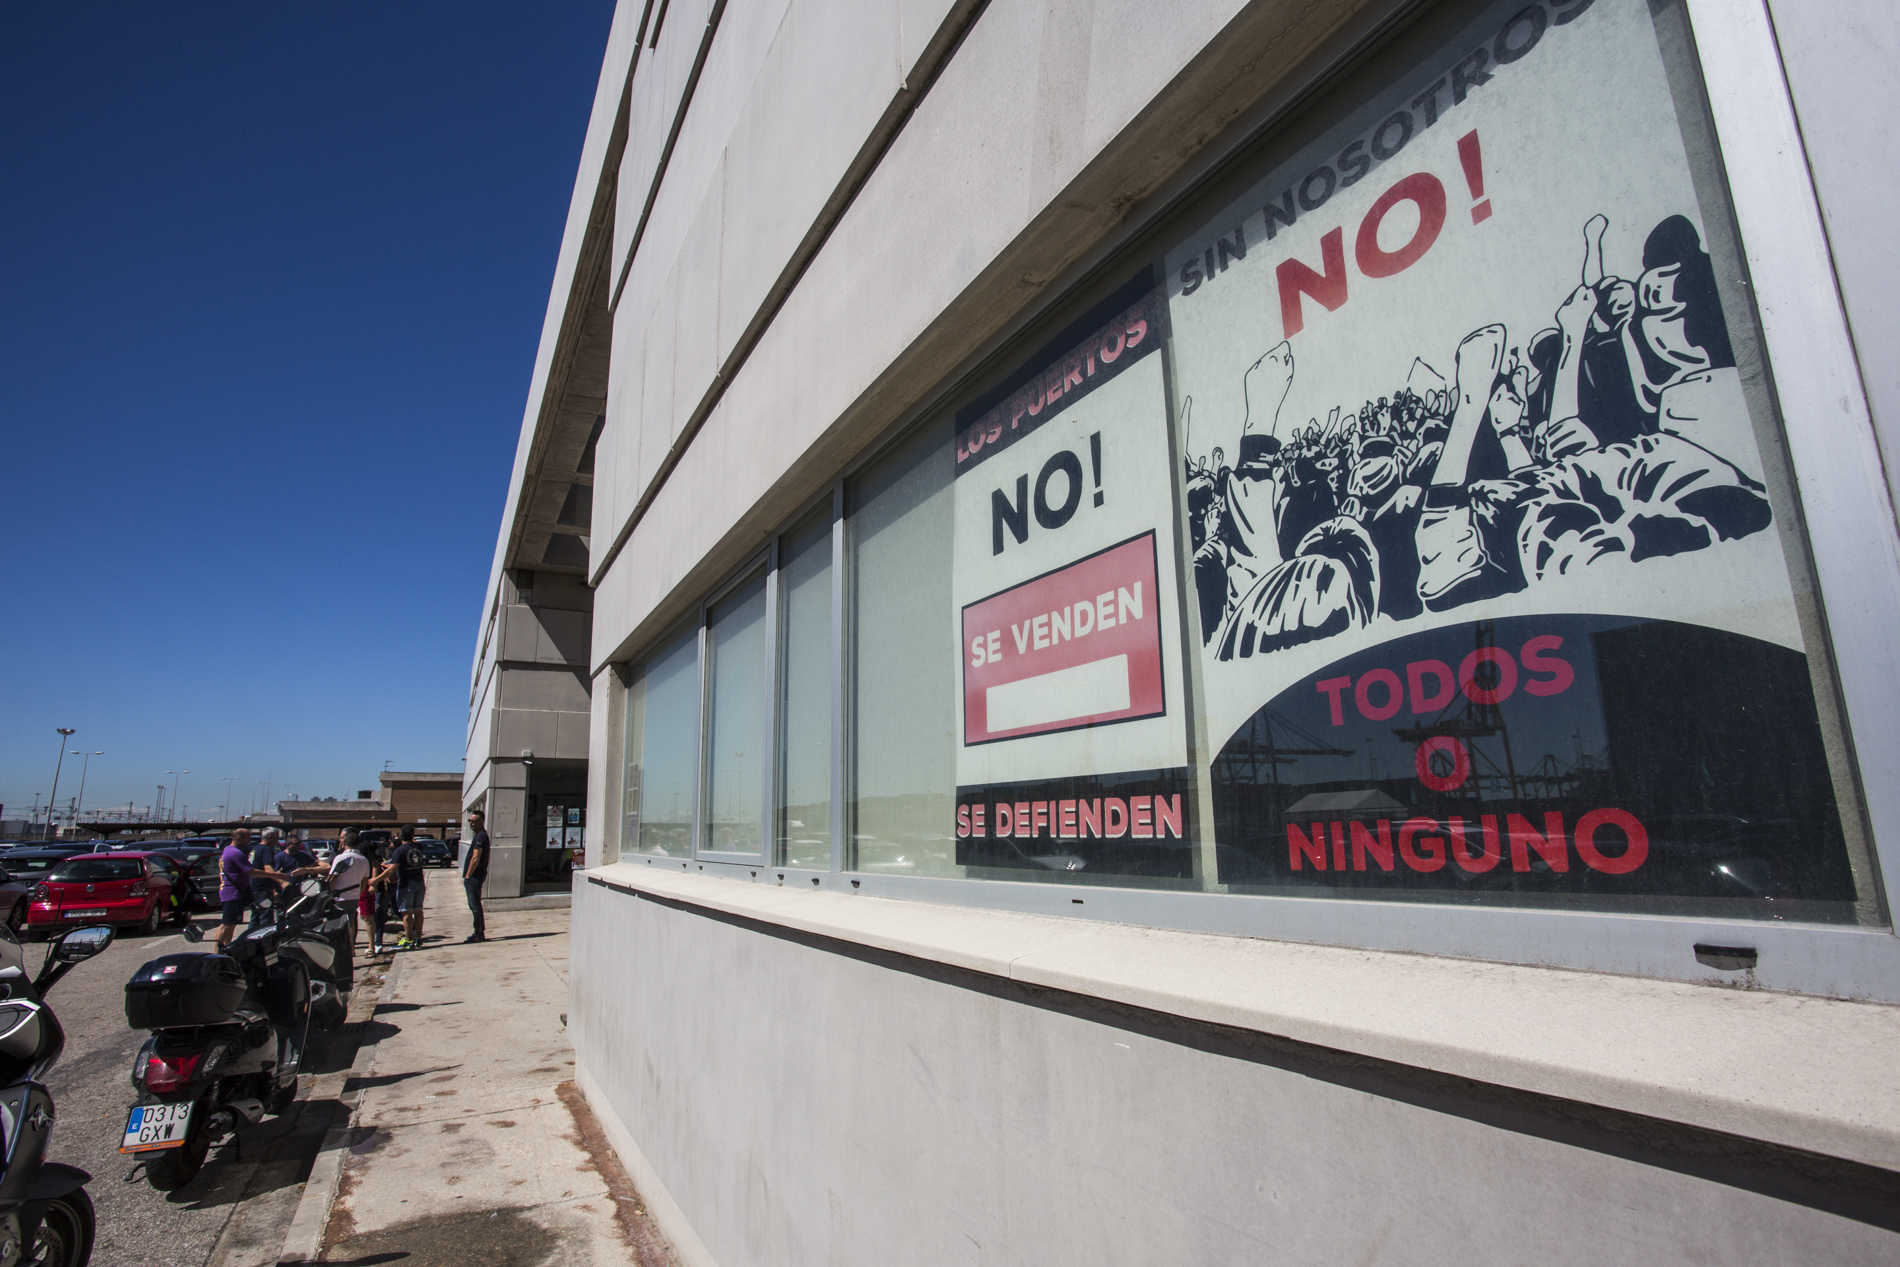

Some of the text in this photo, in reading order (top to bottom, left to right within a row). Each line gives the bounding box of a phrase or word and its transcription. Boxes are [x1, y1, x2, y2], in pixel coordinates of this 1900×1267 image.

[1180, 223, 1247, 297] SIN
[1275, 128, 1493, 340] NO!
[957, 308, 1148, 464] LOS PUERTOS
[991, 430, 1104, 557] NO!
[970, 580, 1144, 669] SE VENDEN
[1315, 634, 1575, 727] TODOS
[1415, 735, 1470, 792] O
[956, 793, 1183, 839] SE DEFIENDEN
[1286, 807, 1650, 875] NINGUNO
[139, 1123, 175, 1143] GXW
